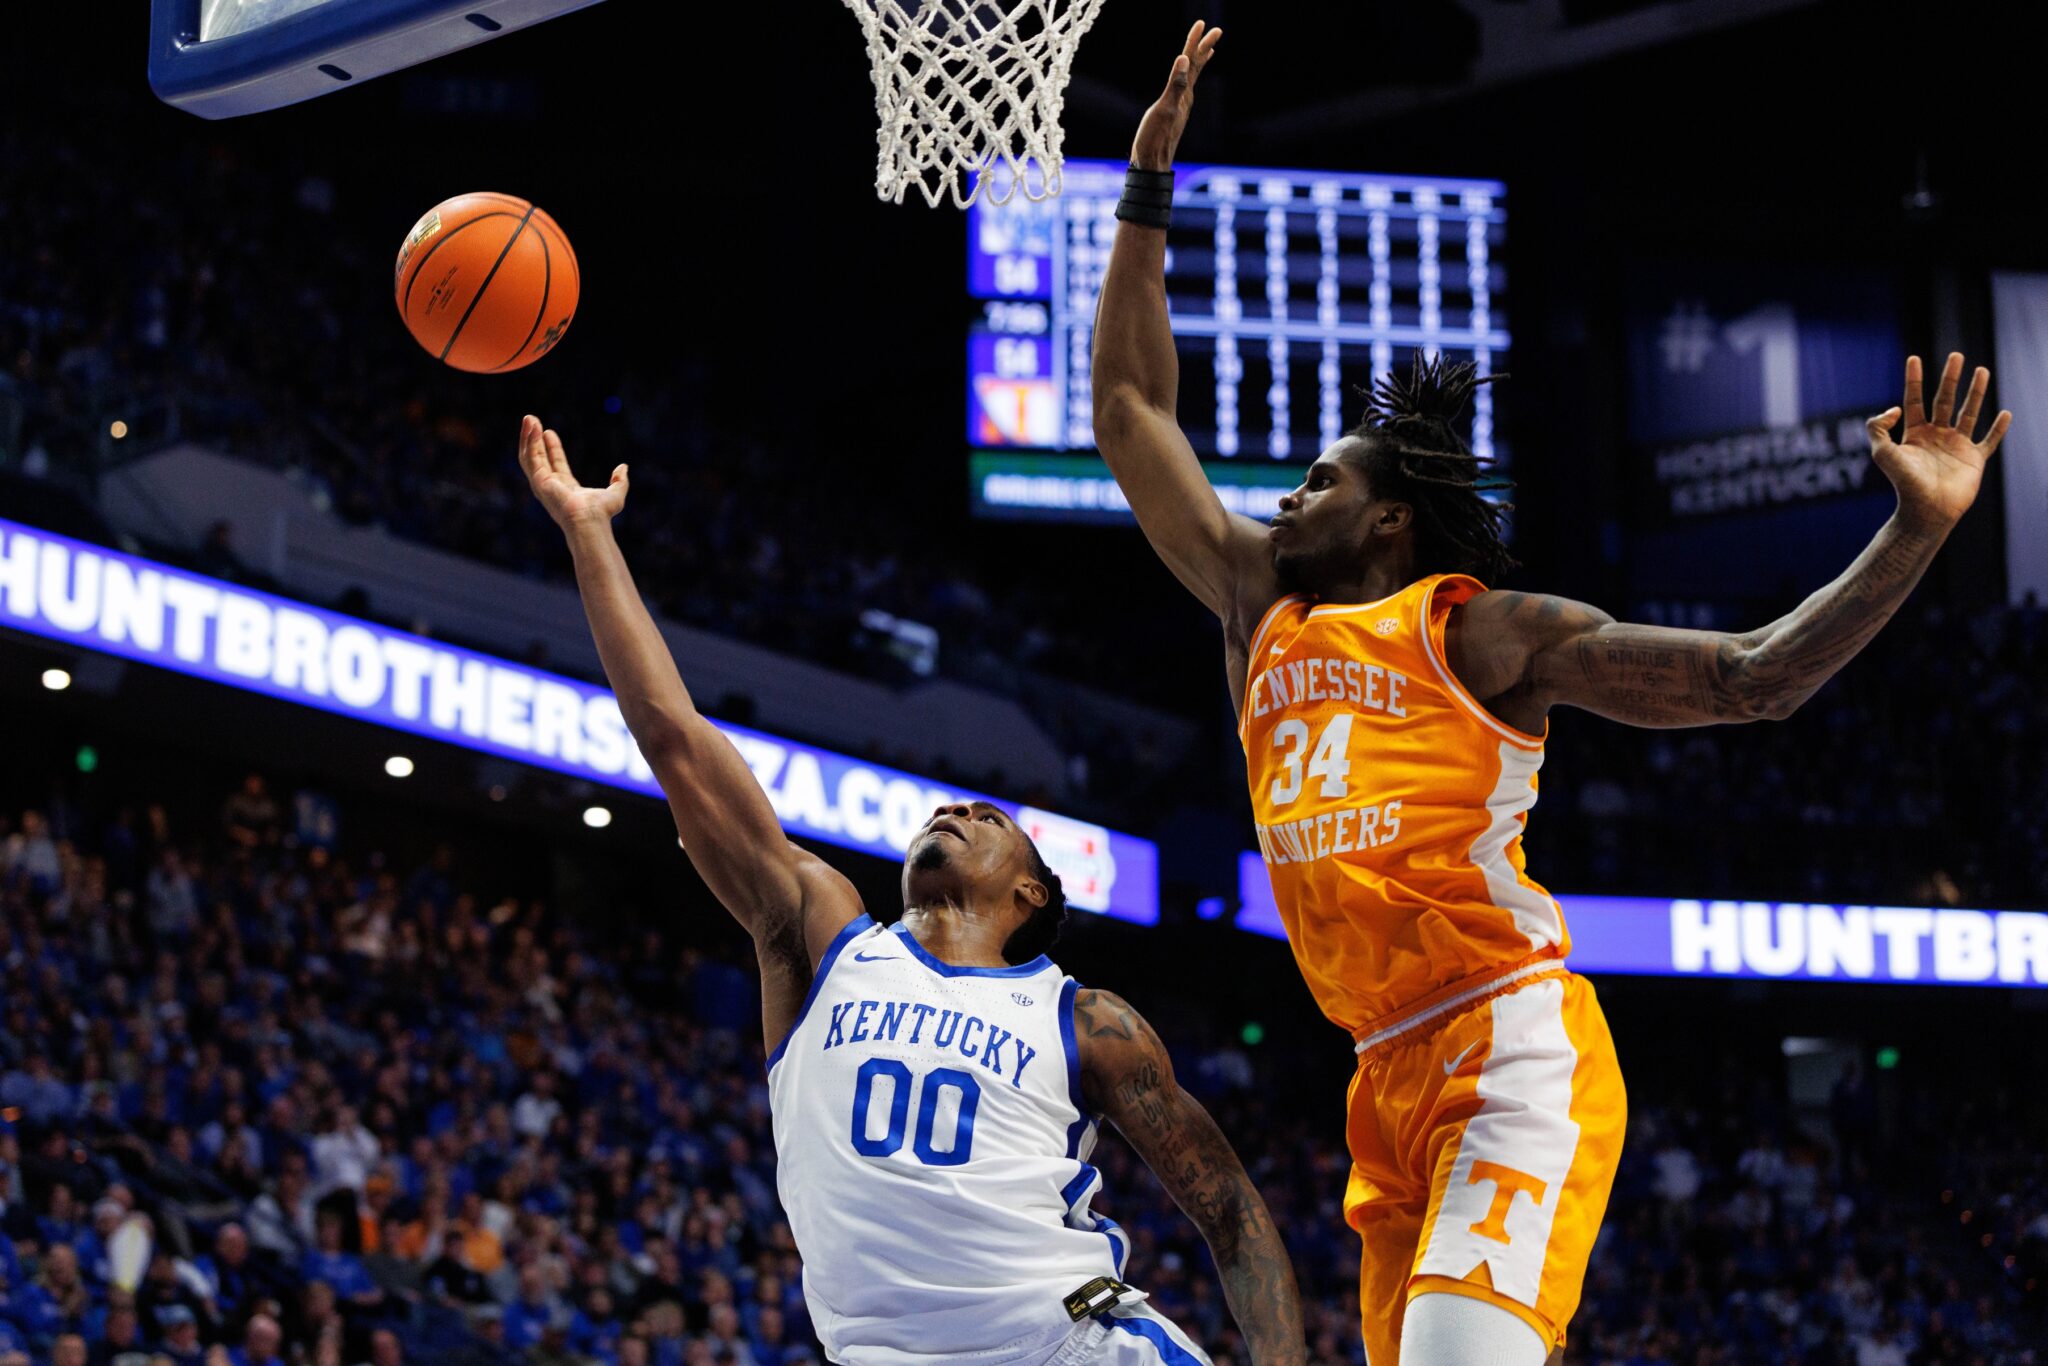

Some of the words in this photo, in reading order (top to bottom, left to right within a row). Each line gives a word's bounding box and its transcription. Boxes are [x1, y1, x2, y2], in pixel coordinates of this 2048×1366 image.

[1670, 456, 1869, 516] KENTUCKY
[1270, 713, 1354, 806] 34
[1255, 800, 1402, 865] OLUNTEERS
[823, 1000, 1036, 1089] KENTUCKY
[851, 1057, 981, 1166] 00
[1467, 1159, 1548, 1246] T
